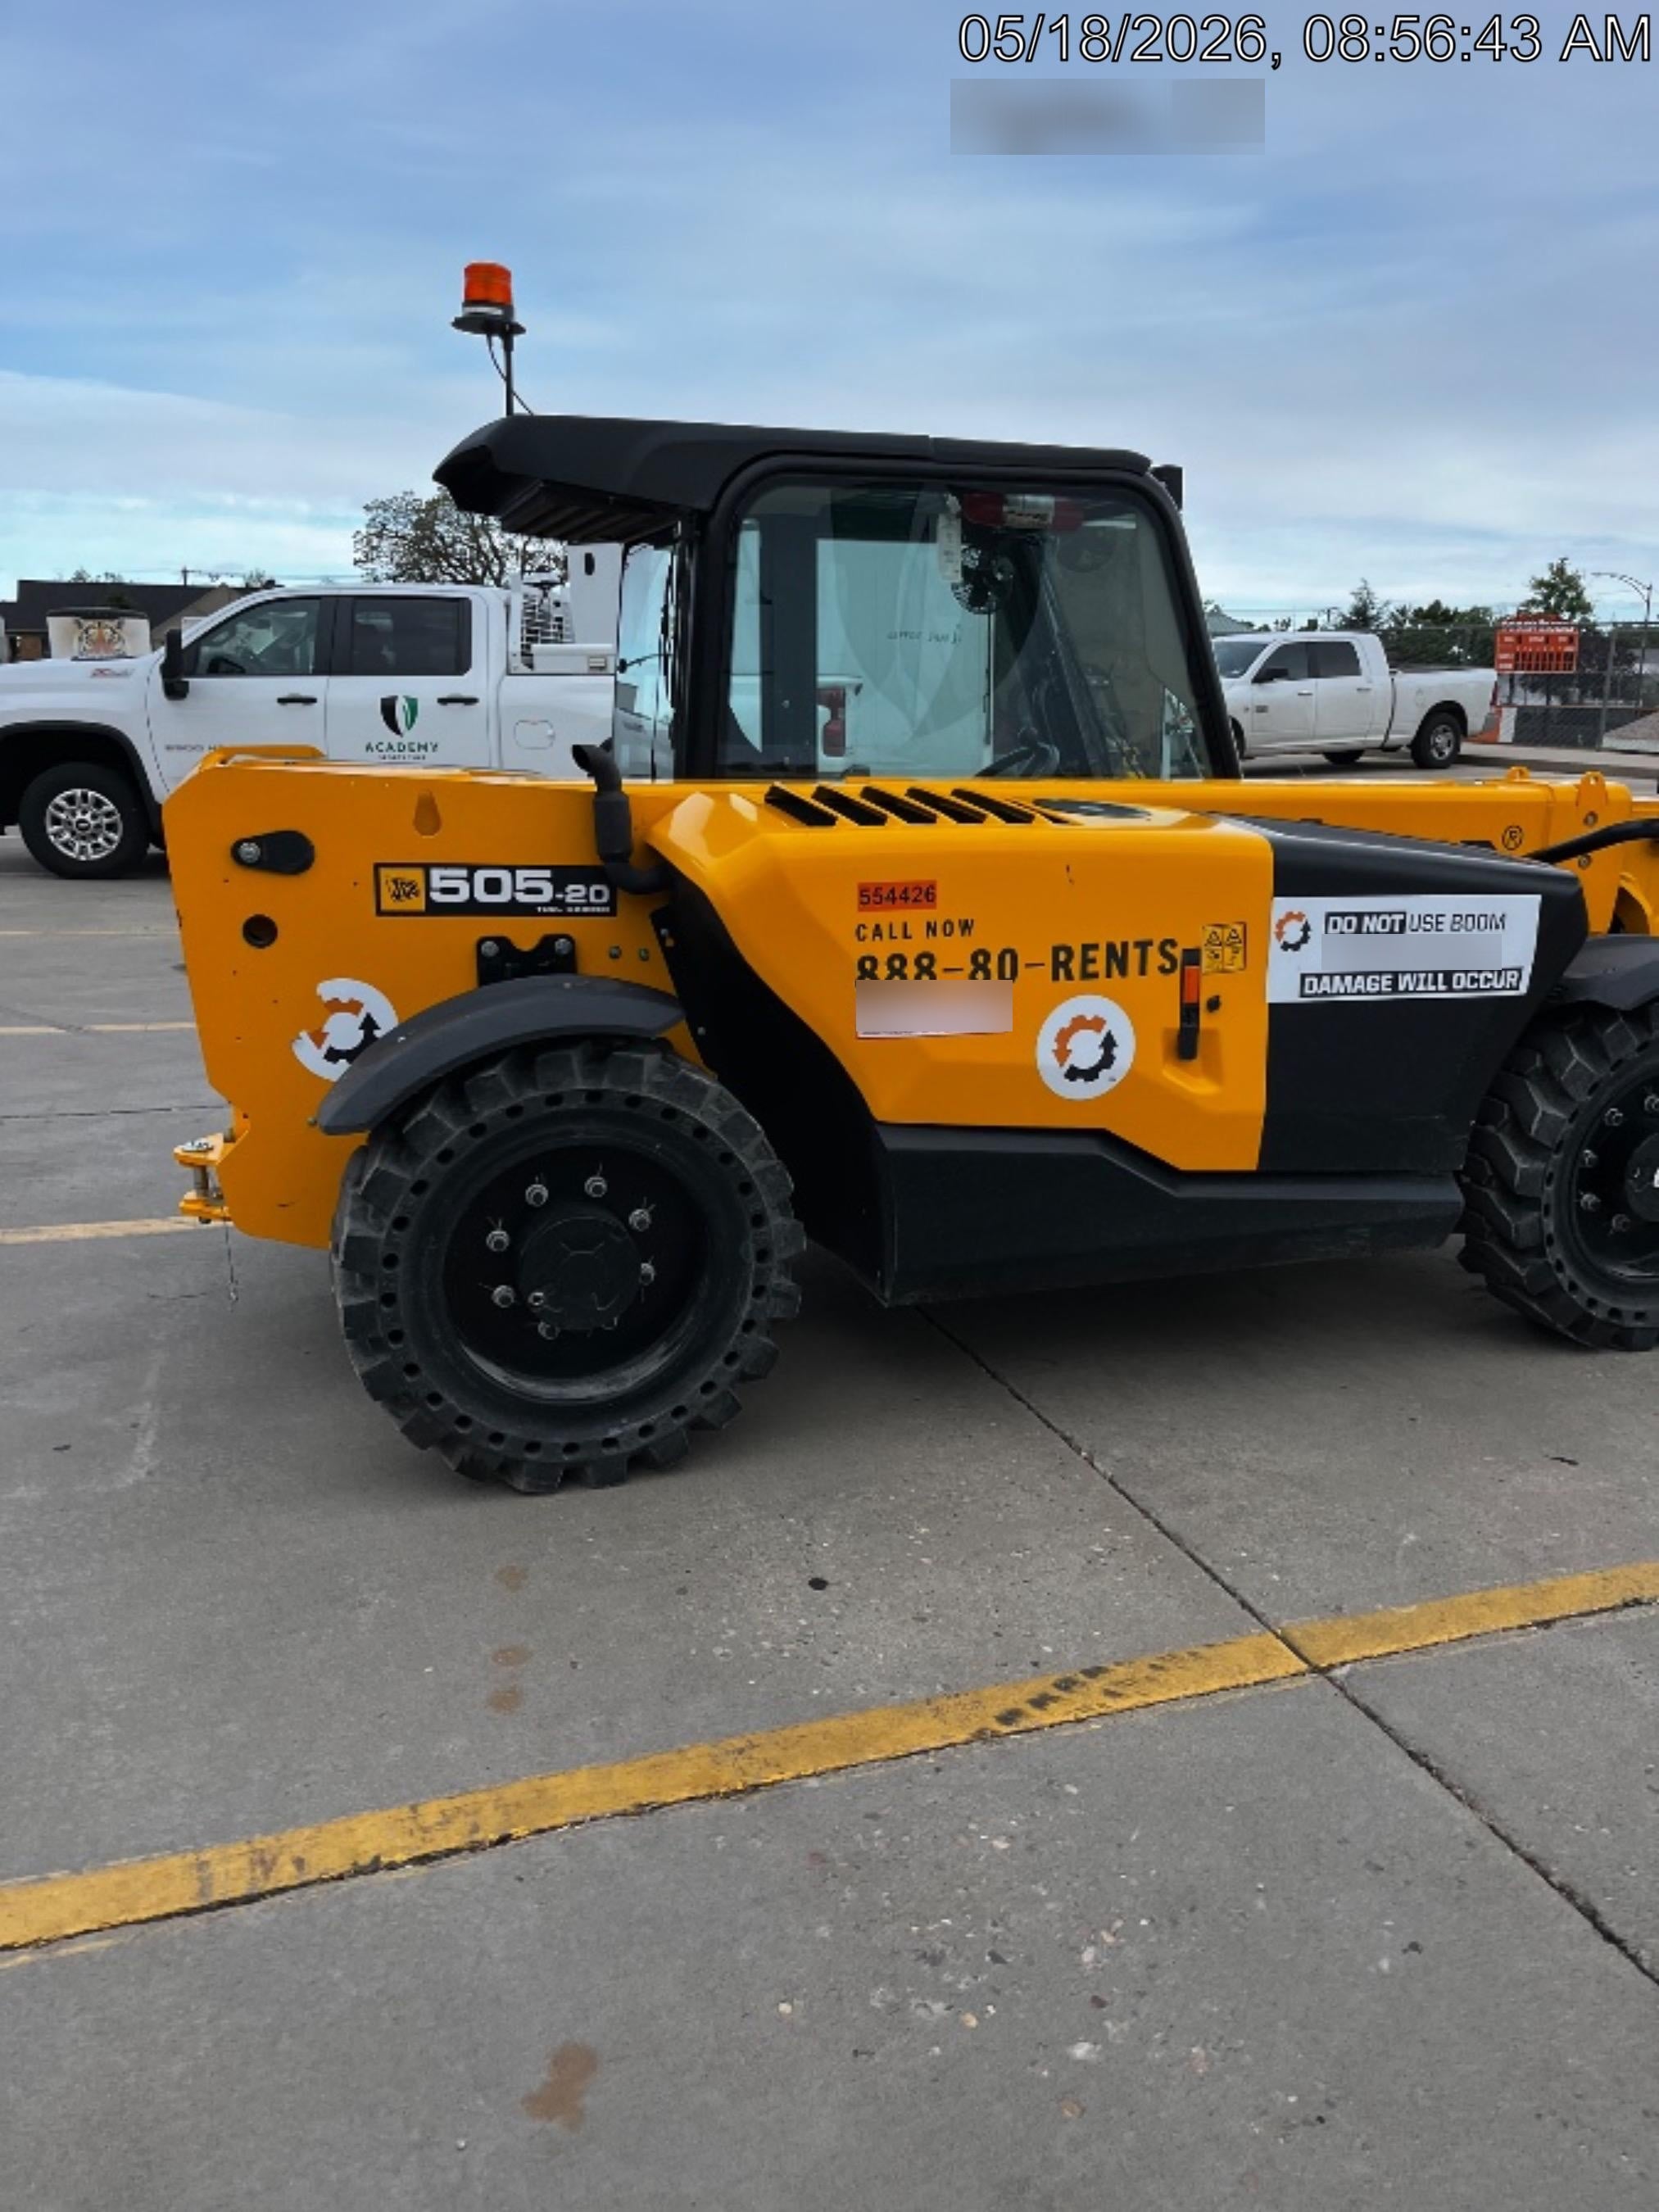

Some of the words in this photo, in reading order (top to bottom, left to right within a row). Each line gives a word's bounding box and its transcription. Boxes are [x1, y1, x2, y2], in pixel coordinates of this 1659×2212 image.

[365, 741, 439, 753] ACADEMY
[428, 867, 610, 904] 505-20
[859, 884, 936, 906] 554426
[855, 921, 913, 942] CALL
[926, 918, 975, 939] NOW
[1327, 916, 1358, 933] DO
[1362, 914, 1404, 933] NOT
[1408, 913, 1445, 932] USE
[1449, 912, 1507, 932] BOOM
[1303, 974, 1393, 995] DAMAGE
[1398, 972, 1448, 992] WILL
[1452, 969, 1521, 990] OCCUR
